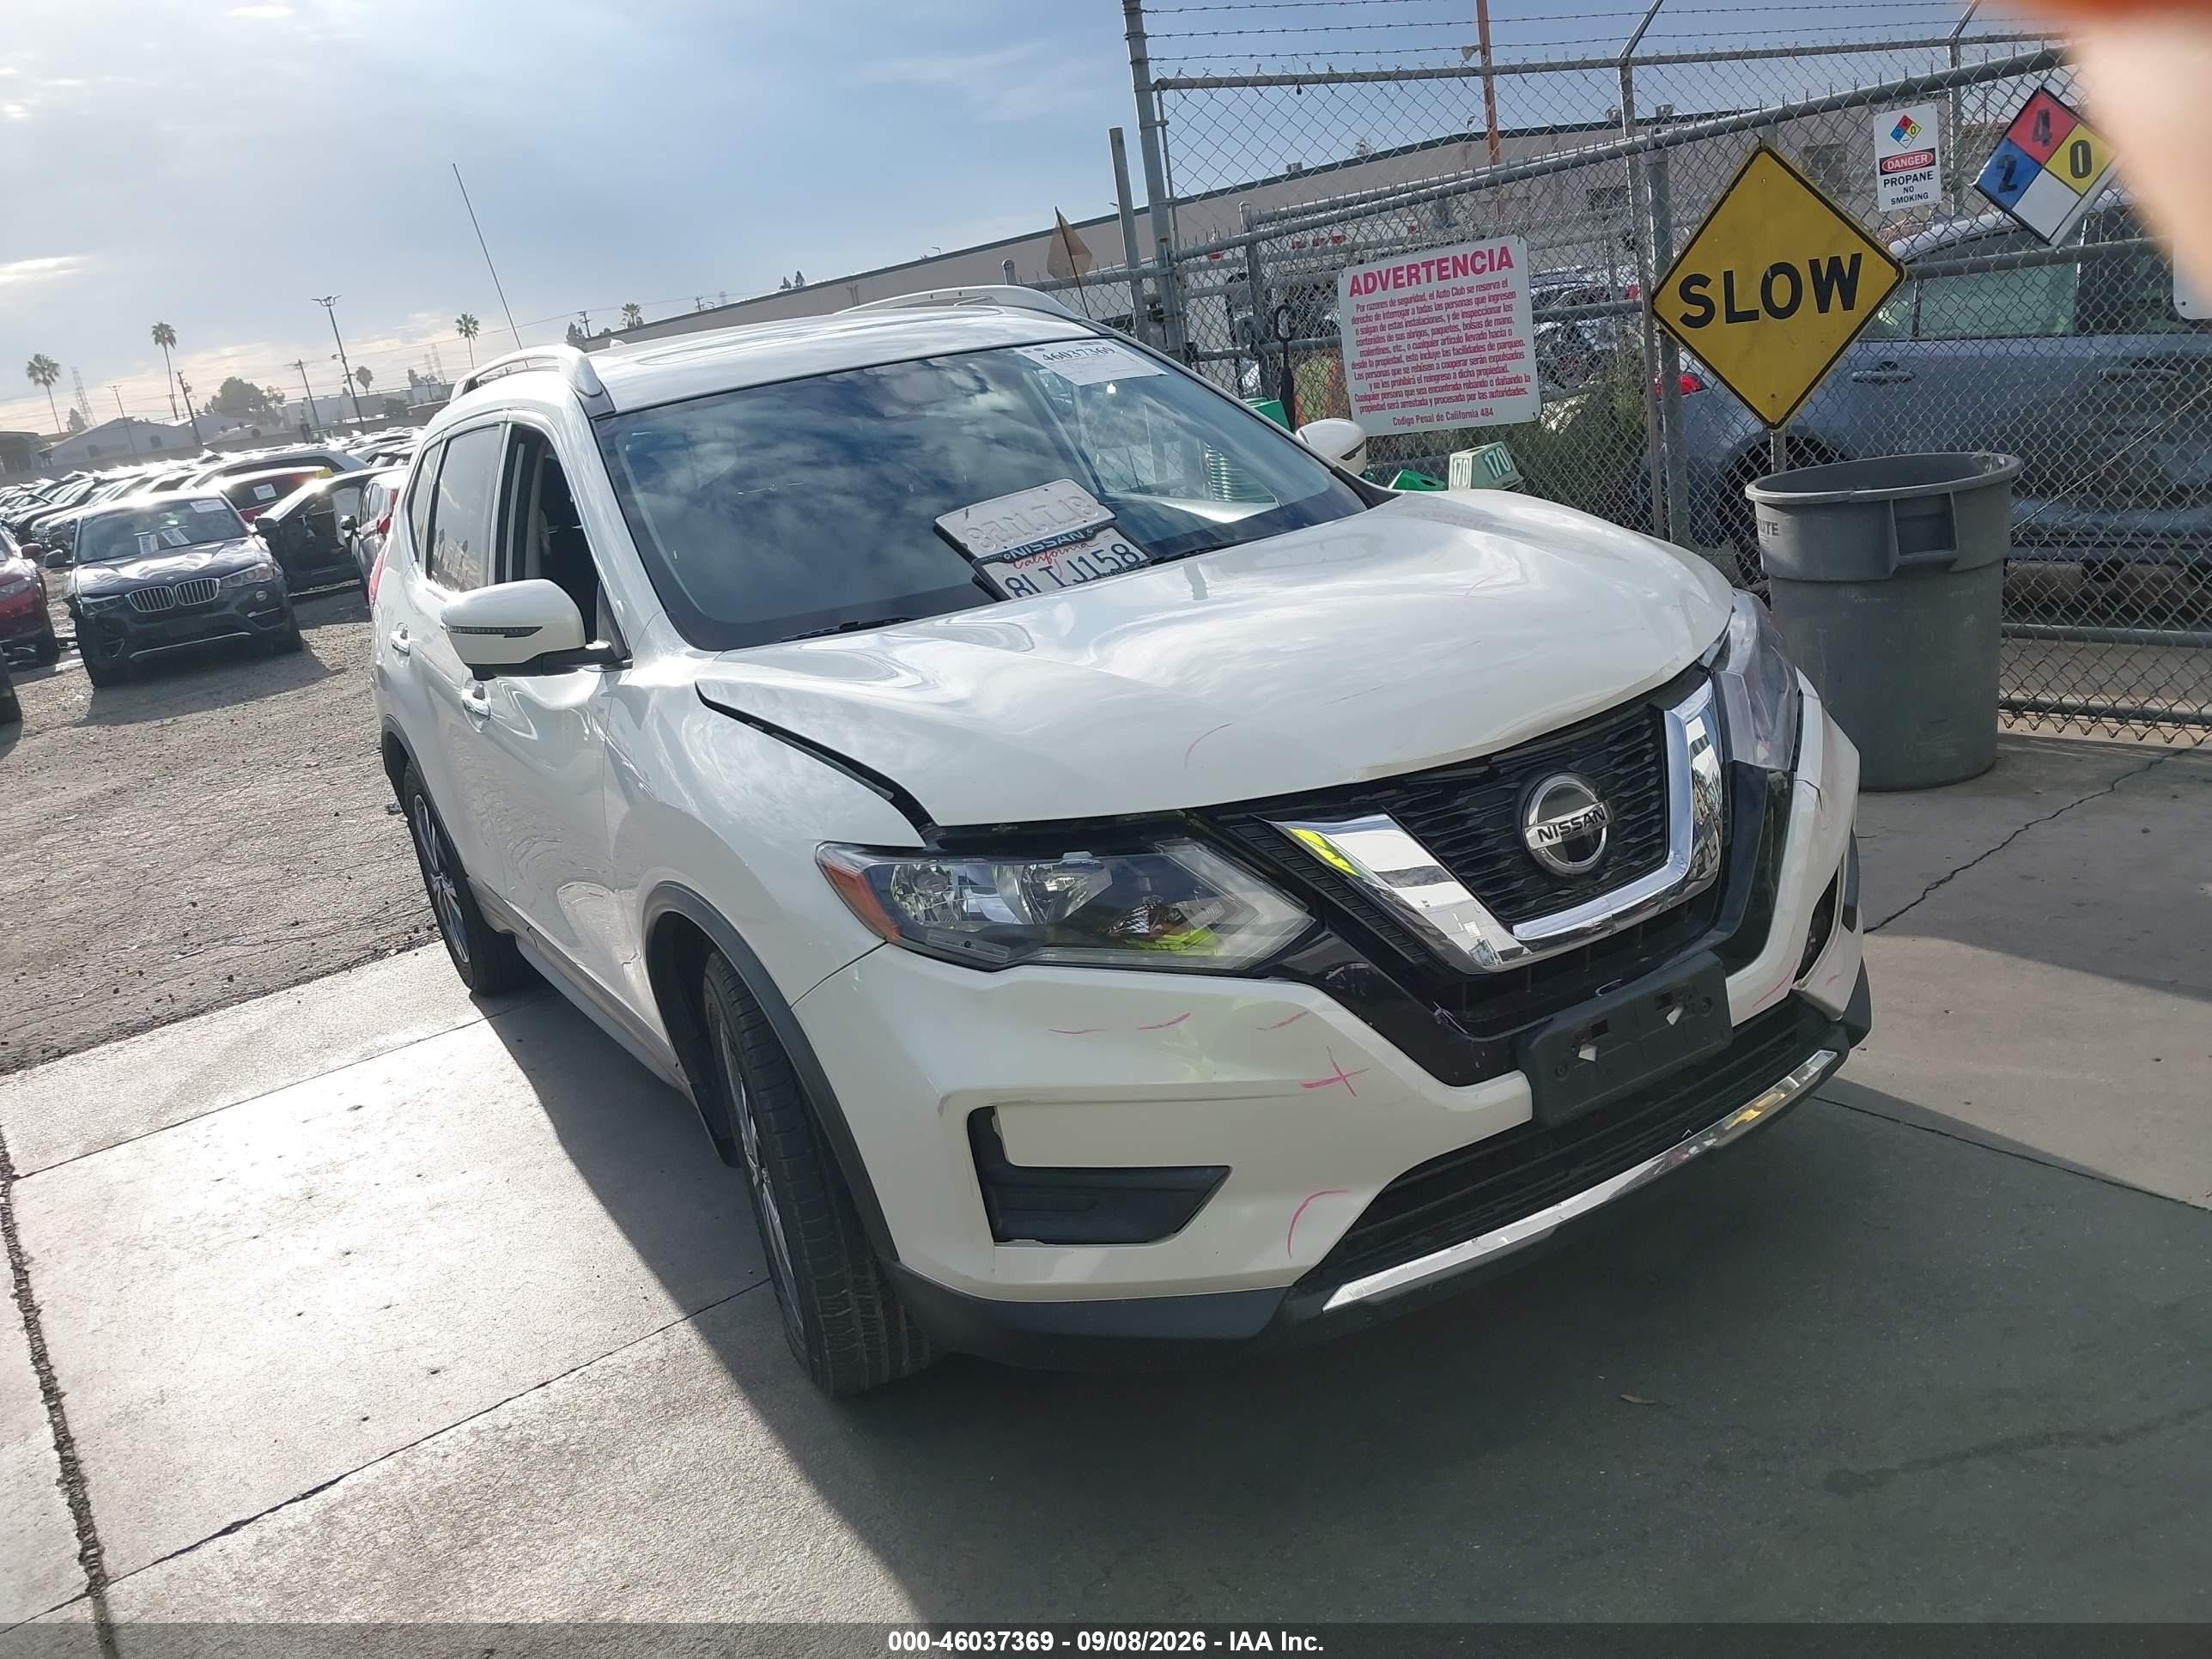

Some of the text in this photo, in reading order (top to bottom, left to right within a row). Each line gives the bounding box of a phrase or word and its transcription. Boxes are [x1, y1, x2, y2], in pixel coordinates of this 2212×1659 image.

[1911, 126, 1917, 136] 0
[2033, 108, 2052, 145] 4
[1887, 153, 1928, 171] DANGER
[1996, 140, 2092, 193] 2 0
[1883, 171, 1934, 188] PROPANE
[1903, 185, 1914, 194] NO
[1891, 191, 1929, 205] SMOKING
[1349, 246, 1514, 297] ADVERTENCIA
[1356, 302, 1364, 312] Por
[1366, 301, 1388, 310] razones
[1389, 297, 1395, 307] de
[1428, 290, 1434, 300] el
[1436, 288, 1449, 299] Auto
[1451, 285, 1465, 296] Club
[1475, 282, 1500, 292] reserva
[1501, 278, 1508, 288] el
[1374, 312, 1381, 320] de
[1382, 307, 1410, 321] interrogar
[1416, 303, 1432, 313] todas
[1434, 301, 1443, 311] las
[1444, 298, 1473, 312] personas
[1474, 296, 1486, 307] que
[1487, 289, 1516, 305] ingresen
[1679, 253, 1862, 329] SLOW
[1379, 322, 1386, 331] de
[1387, 319, 1402, 330] estas
[1446, 313, 1450, 323] y
[1451, 310, 1459, 320] de
[1461, 303, 1501, 320] inspeccionar
[1503, 301, 1512, 312] los
[1386, 332, 1394, 342] de
[1462, 319, 1483, 331] bolsas
[1484, 318, 1492, 327] de
[1412, 337, 1438, 351] cualquier
[1465, 330, 1487, 342] llevado
[1489, 327, 1506, 338] hacia
[1042, 346, 1115, 361] 46037369
[1351, 359, 1367, 369] desde
[1368, 358, 1374, 367] la
[1405, 352, 1419, 362] esto
[1419, 349, 1441, 362] incluye
[1442, 347, 1451, 357] las
[1452, 343, 1486, 356] facilidades
[1486, 341, 1495, 351] de
[1497, 339, 1525, 352] parqueo.
[1354, 371, 1364, 380] Las
[1364, 369, 1390, 380] personas
[1391, 368, 1401, 377] que
[1441, 359, 1468, 371] cooperar
[1369, 382, 1372, 391] y
[1381, 379, 1389, 387] les
[1416, 374, 1422, 383] el
[1424, 371, 1451, 385] reingreso
[1457, 368, 1474, 378] dicha
[1354, 391, 1379, 404] Cualquier
[1381, 390, 1403, 400] persona
[1404, 388, 1415, 398] que
[1428, 381, 1462, 393] encontrada
[1462, 378, 1488, 389] robando
[1495, 374, 1523, 386] dañando
[1524, 373, 1530, 382] la
[1358, 401, 1386, 414] propiedad
[1400, 396, 1428, 408] arrestada
[1429, 398, 1432, 406] y
[1433, 392, 1465, 406] procesada
[1467, 392, 1476, 403] por
[1478, 390, 1488, 399] las
[1488, 385, 1528, 398] autoridades.
[1415, 412, 1433, 423] Penal
[1436, 411, 1443, 421] de
[1445, 408, 1478, 420] California
[1480, 406, 1493, 416] 484
[1454, 459, 1468, 487] 170
[1485, 447, 1511, 478] 170
[1009, 531, 1086, 559] NISSAN
[1012, 541, 1100, 569] California
[1537, 807, 1606, 842] NISSAN
